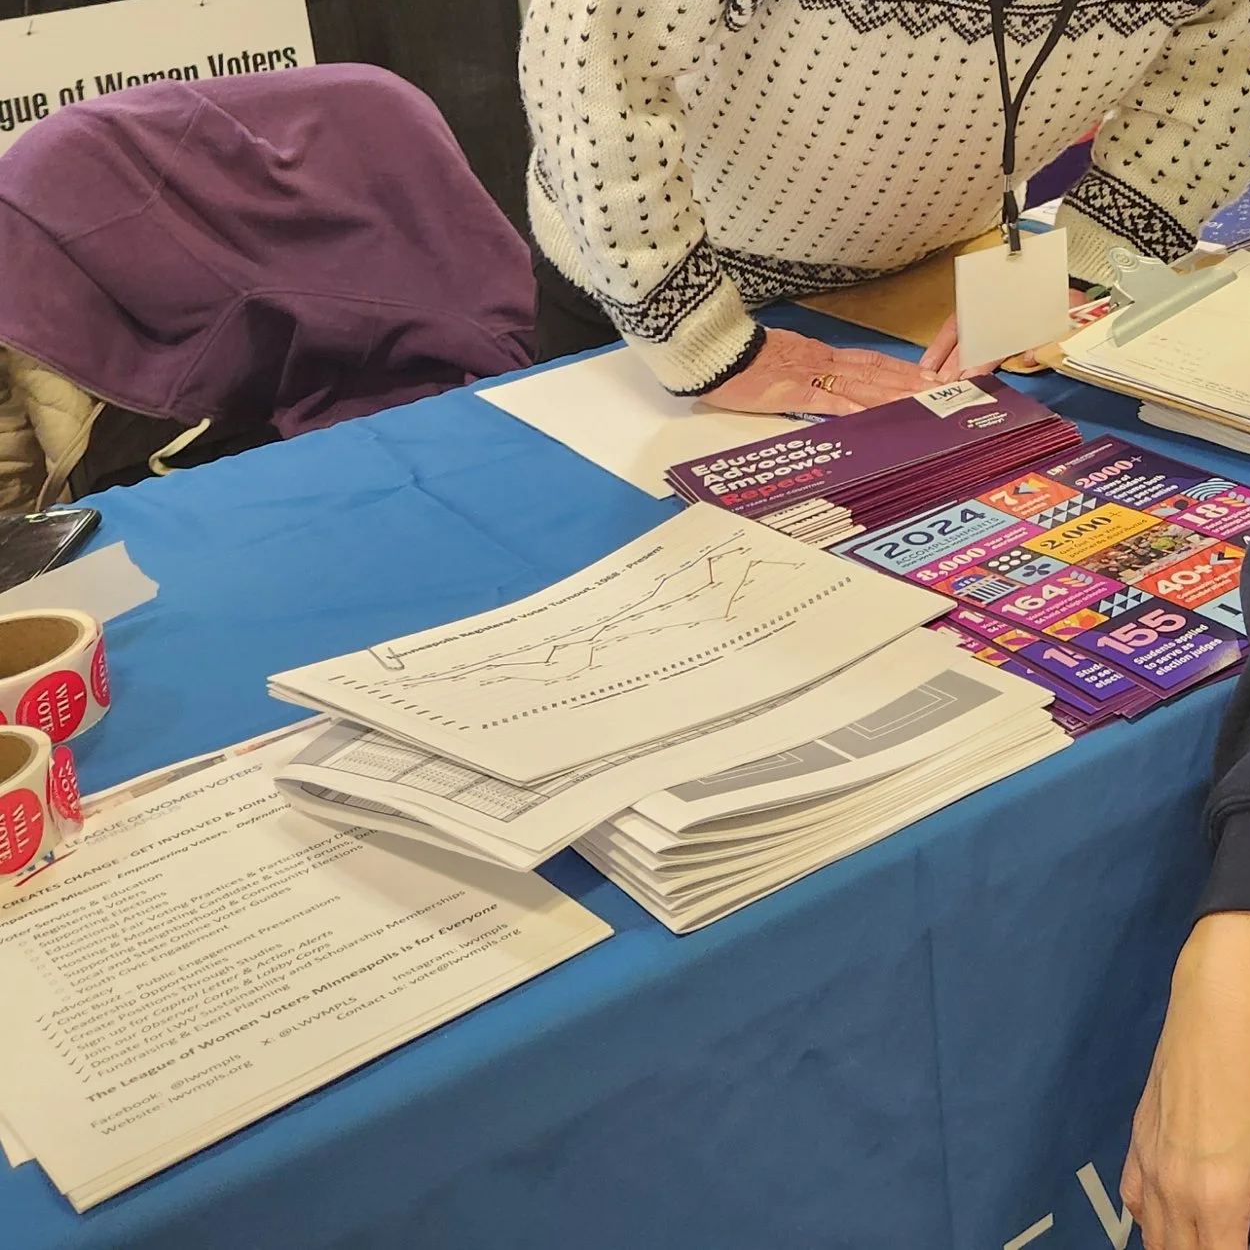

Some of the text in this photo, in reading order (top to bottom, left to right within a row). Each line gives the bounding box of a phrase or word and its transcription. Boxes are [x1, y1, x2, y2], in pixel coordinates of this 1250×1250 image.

[691, 439, 812, 477] Educate,
[703, 441, 841, 486] Advocate,
[709, 449, 852, 495] Empower.
[1075, 456, 1142, 489] 2000+
[719, 468, 832, 506] Repeat.
[989, 491, 1018, 505] 7
[874, 508, 986, 560] 2024
[1040, 512, 1122, 550] 2,000+
[1177, 504, 1229, 527] 18
[896, 518, 999, 566] ACCOMPLISHMENTS
[917, 548, 986, 581] 8,000
[1157, 565, 1212, 595] 40+
[460, 617, 518, 638] Registered
[518, 606, 548, 618] Voter
[626, 546, 664, 568] Present
[1002, 584, 1069, 616] 164
[1097, 609, 1186, 655] 155
[1134, 624, 1209, 665] Students applied
[1144, 643, 1194, 670] to serve as
[1156, 638, 1223, 676] election judges
[37, 690, 54, 733] VOTE
[55, 683, 71, 728] WILL
[74, 691, 84, 700] I
[12, 804, 30, 853] WILL
[32, 813, 41, 822] I
[65, 820, 125, 848] LEAGUE
[128, 812, 144, 823] OF
[145, 788, 204, 814] WOMEN
[2, 884, 61, 909] CREATES
[64, 858, 120, 885] CHANGE
[130, 845, 158, 858] GET
[159, 816, 222, 846] INVOLVED
[239, 798, 266, 812] JOIN
[393, 923, 508, 981] Instagram: lwvmpls
[337, 928, 522, 1021] Contact us: vote@lwvmpls.org
[86, 1086, 117, 1102] The
[120, 1058, 176, 1087] League
[180, 1048, 195, 1059] of
[198, 1019, 259, 1050] Women
[261, 994, 310, 1019] Voters
[312, 951, 399, 995] Minneapolis
[415, 933, 435, 946] for
[438, 903, 498, 935] Everyone
[279, 996, 357, 1038] @LWVMPLS
[91, 1053, 241, 1128] Facebook: @lwvmpls
[101, 1060, 253, 1135] Website: lwvmpls.org
